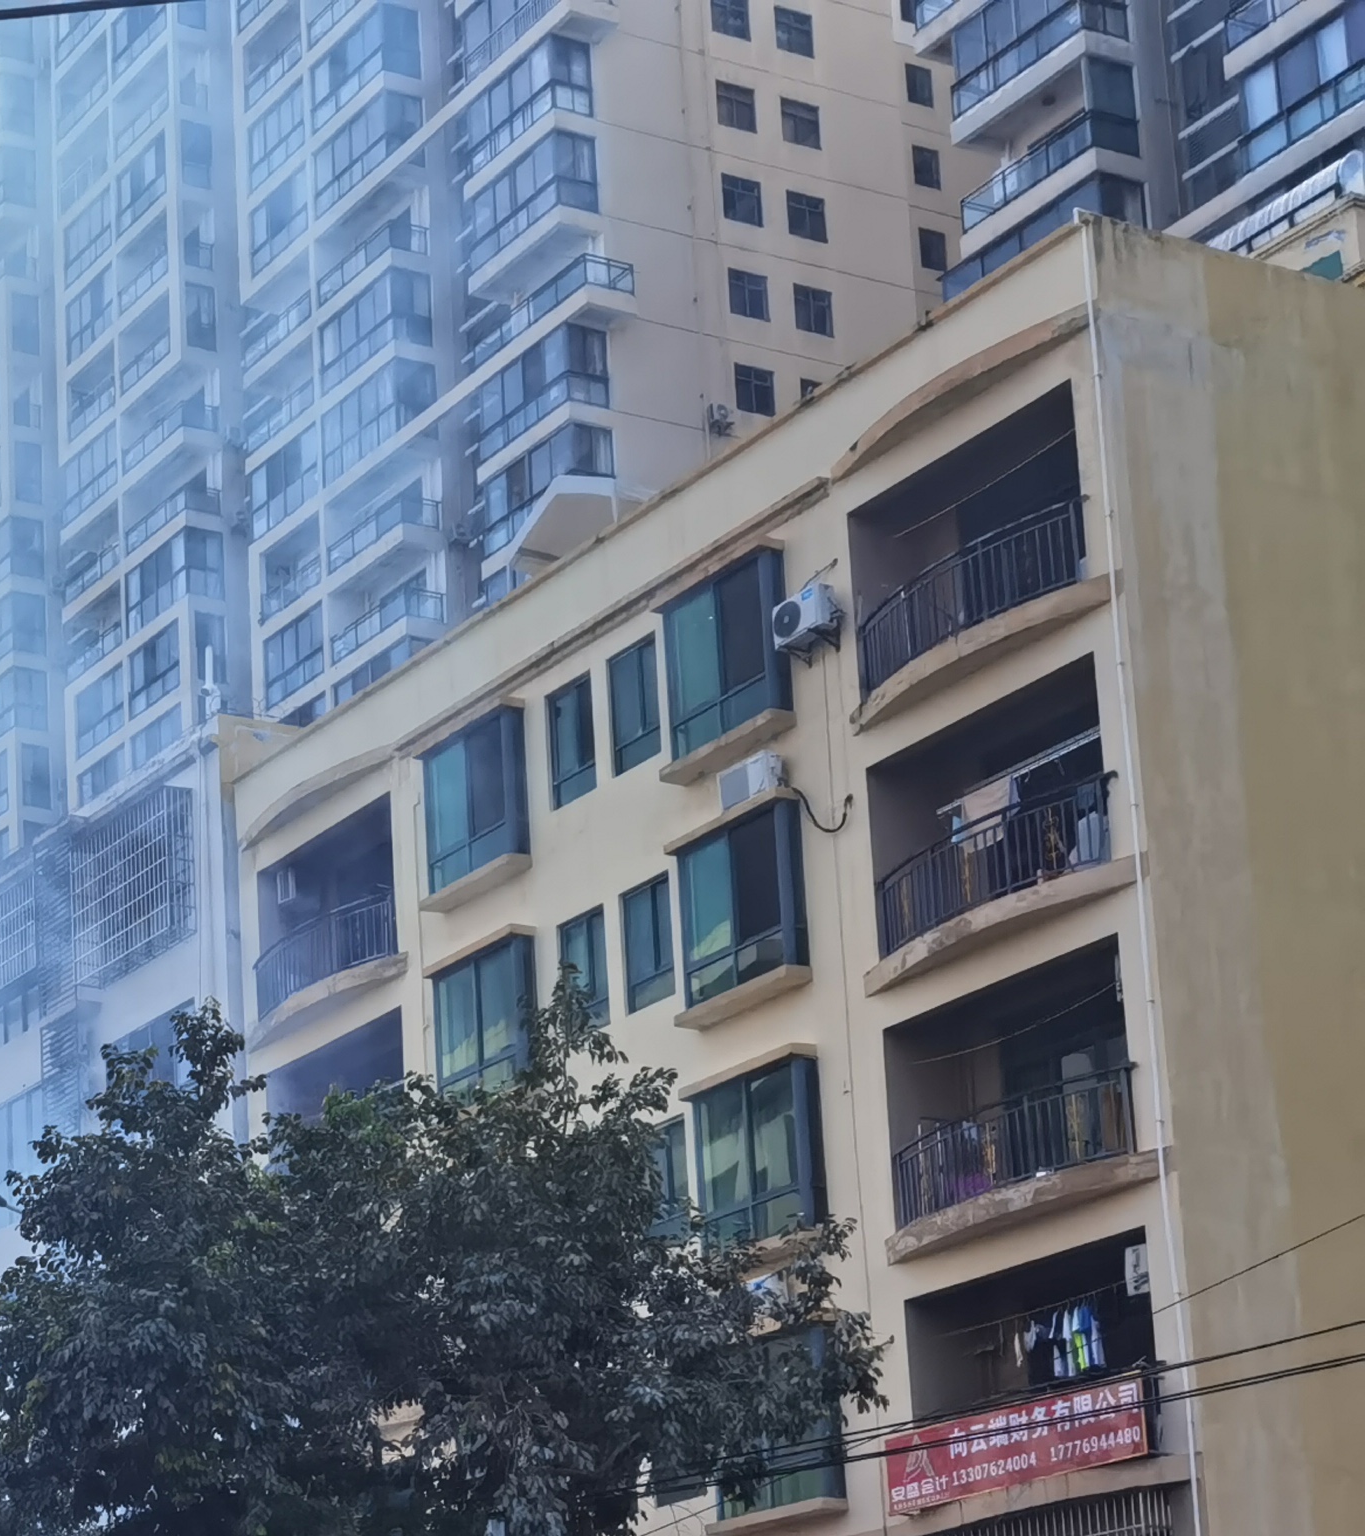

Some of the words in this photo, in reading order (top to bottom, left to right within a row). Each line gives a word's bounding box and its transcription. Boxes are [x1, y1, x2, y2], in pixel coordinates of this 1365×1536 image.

[948, 1381, 1141, 1461] 向云端财务有限公司
[952, 1452, 1037, 1486] 13307624004
[1050, 1424, 1142, 1463] 17776944480
[891, 1475, 949, 1503] 安盛会计
